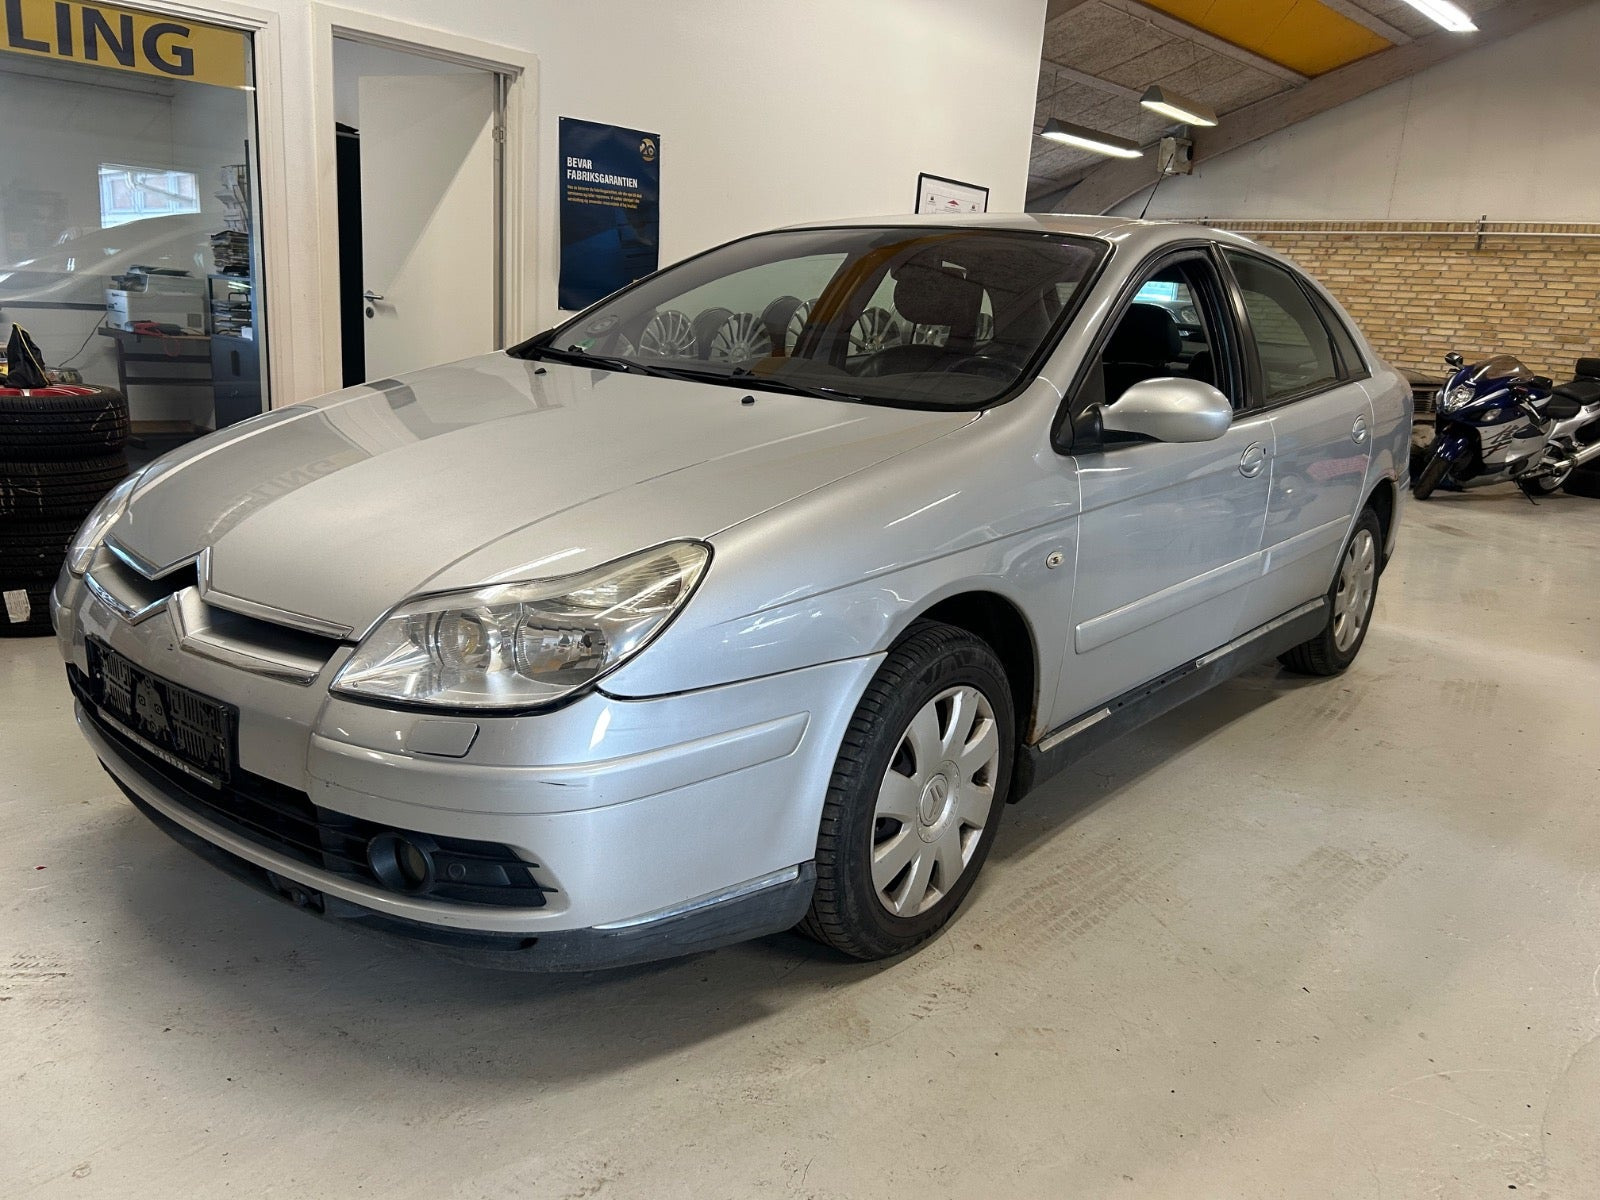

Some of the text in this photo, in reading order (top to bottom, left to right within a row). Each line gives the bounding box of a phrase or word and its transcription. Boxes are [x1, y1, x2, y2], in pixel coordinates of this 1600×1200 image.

[6, 0, 194, 76] LING
[567, 157, 592, 169] BEVAR
[567, 170, 638, 188] FABRIKSGARANTIEN
